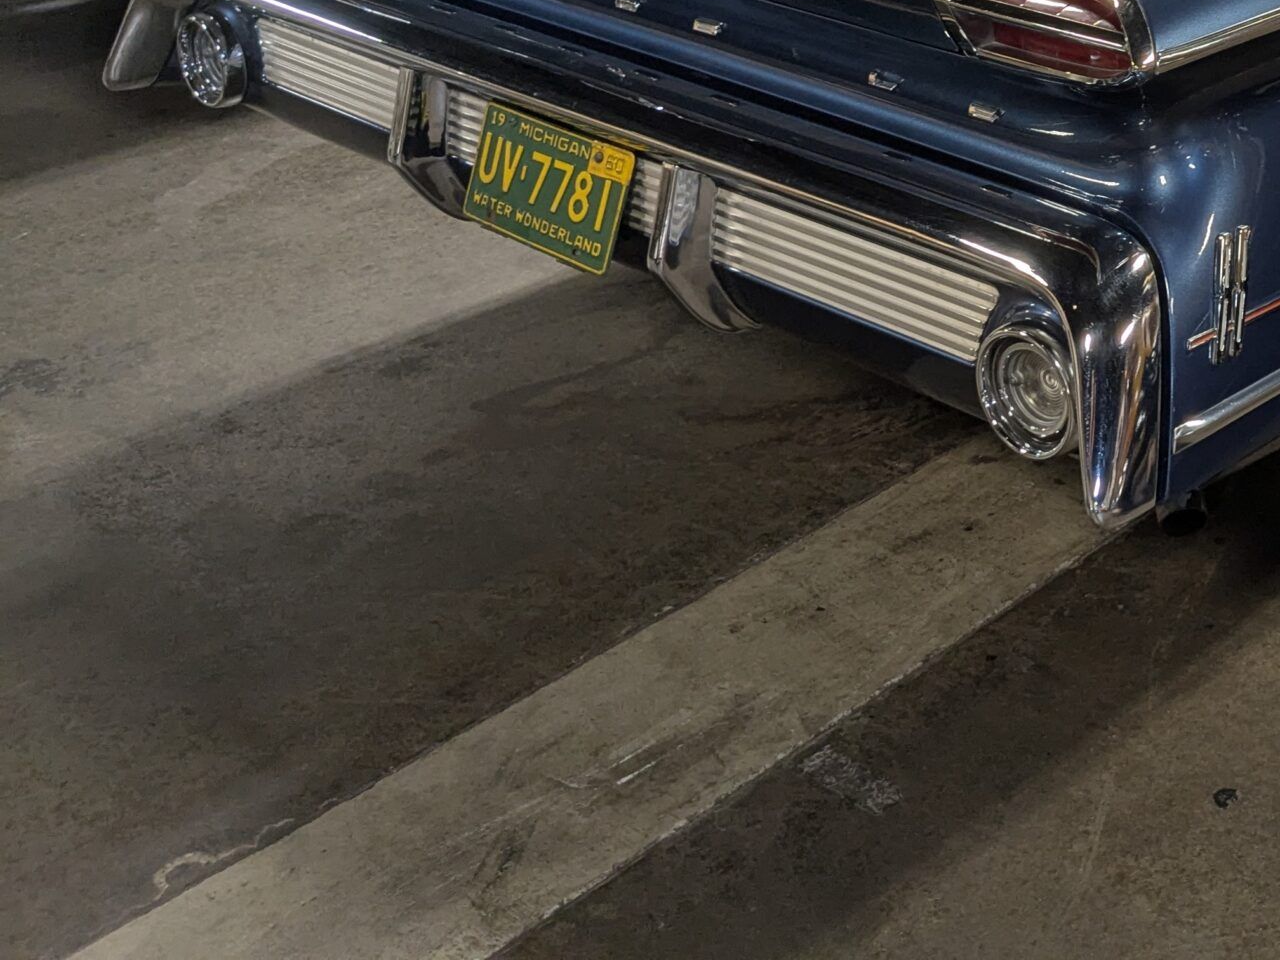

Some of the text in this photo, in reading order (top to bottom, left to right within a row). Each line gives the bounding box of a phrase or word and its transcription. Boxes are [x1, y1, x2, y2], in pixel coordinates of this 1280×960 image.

[491, 111, 506, 126] 19
[518, 122, 592, 160] MICHIGAN
[472, 191, 602, 258] WATER WONDERLAND
